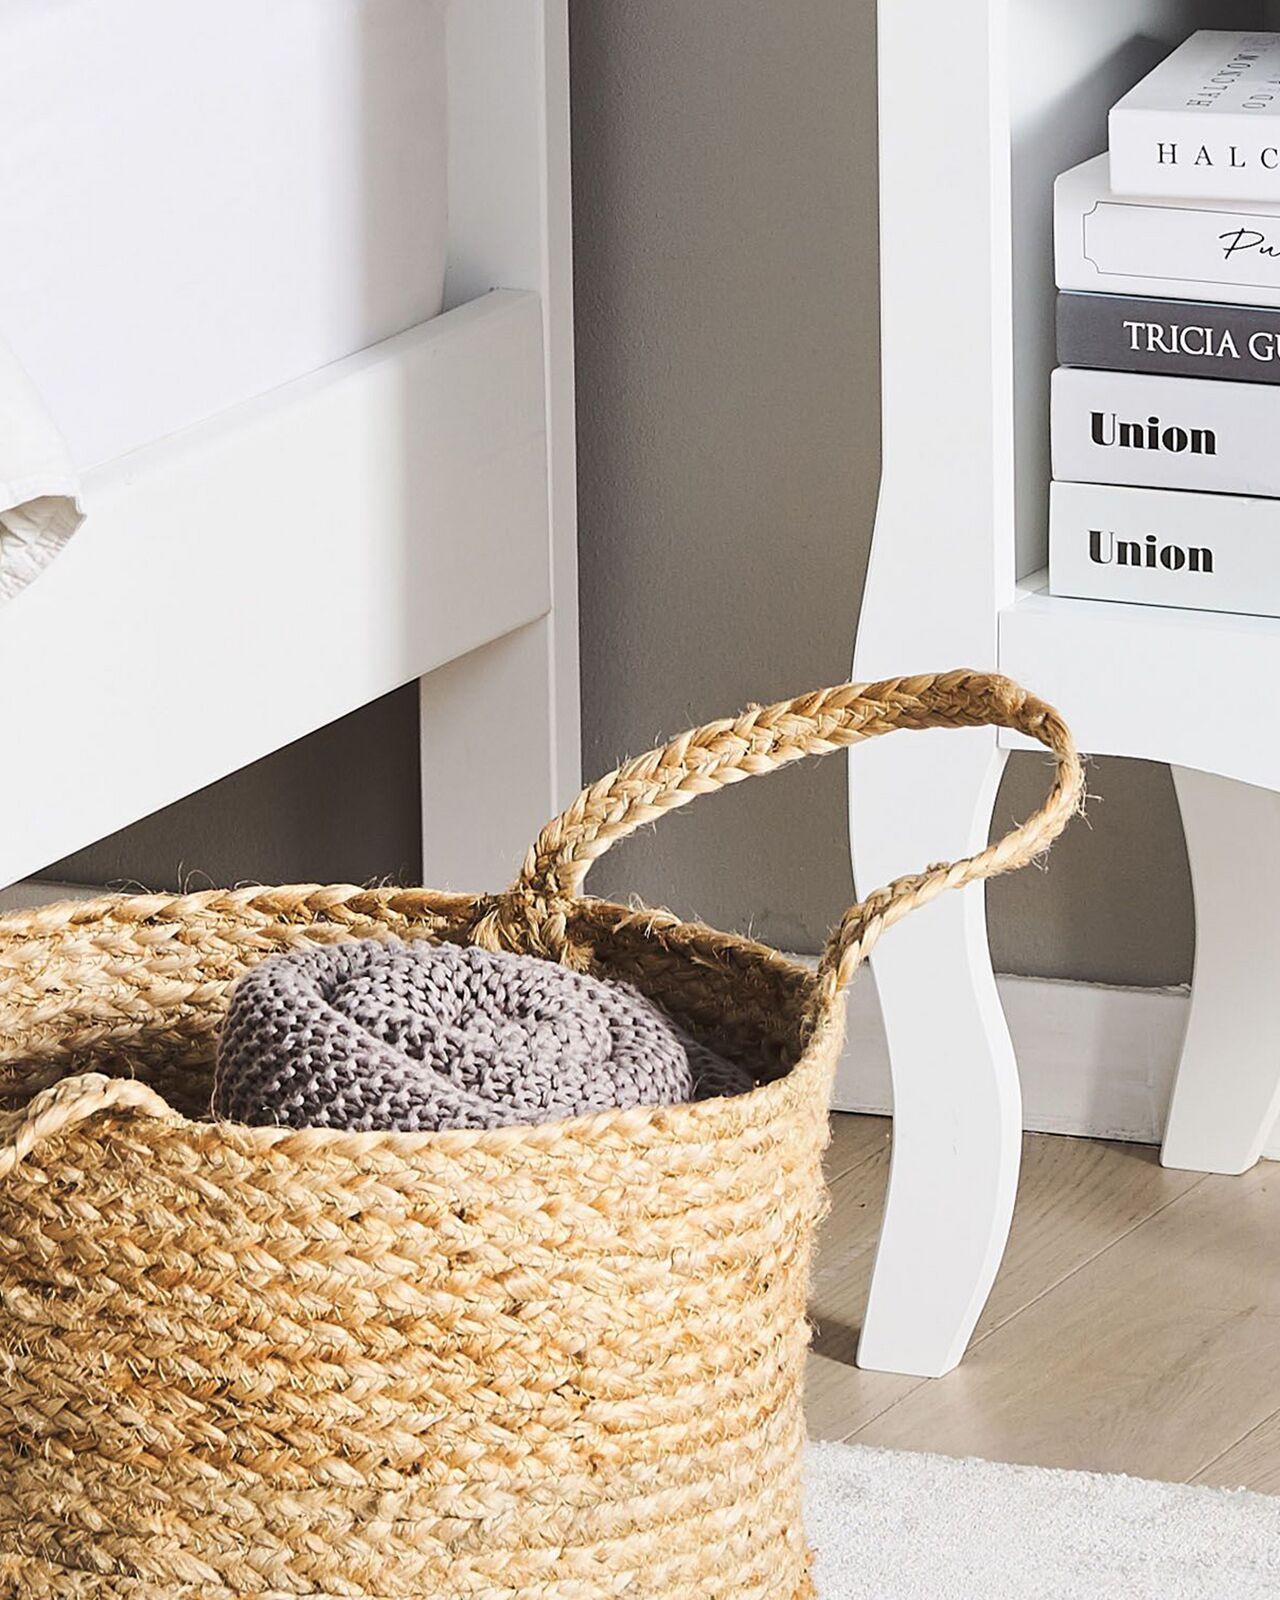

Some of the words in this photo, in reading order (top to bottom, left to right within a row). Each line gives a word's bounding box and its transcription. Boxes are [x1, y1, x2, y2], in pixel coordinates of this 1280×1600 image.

[1123, 320, 1240, 359] TRICIA
[1089, 411, 1218, 456] Union
[1088, 529, 1215, 574] Union
